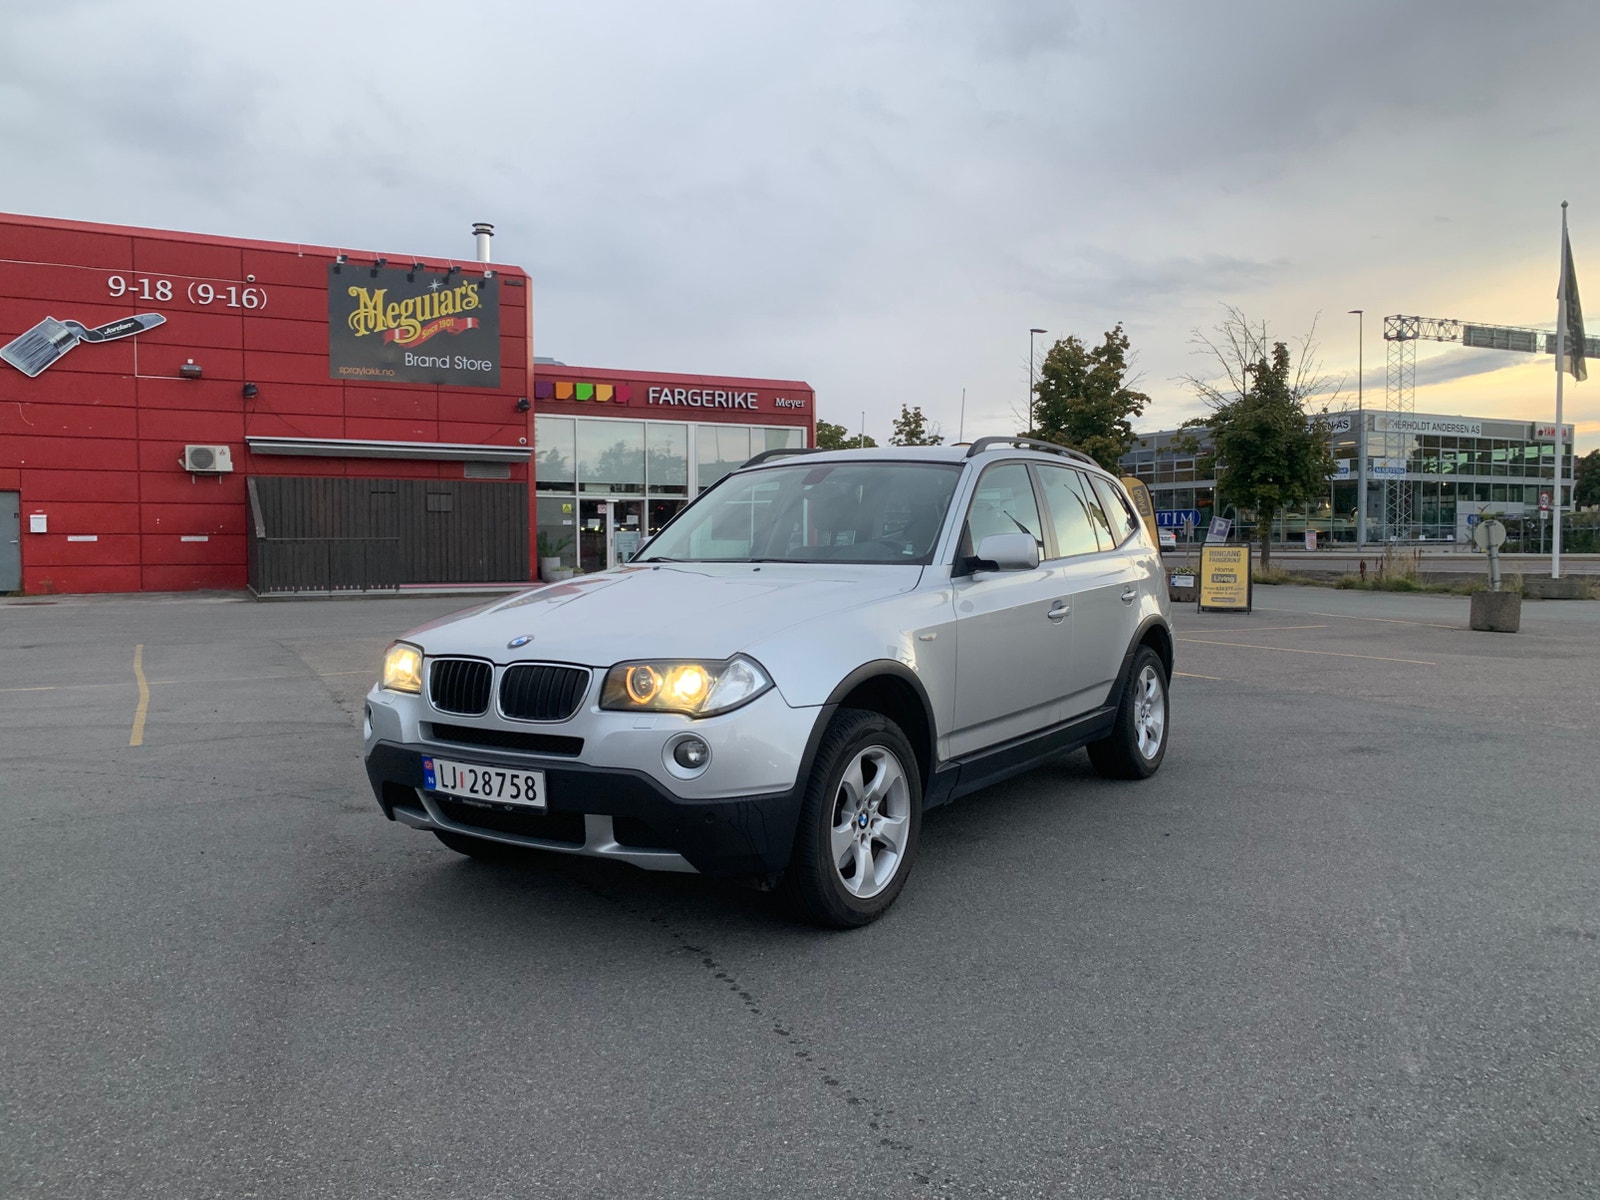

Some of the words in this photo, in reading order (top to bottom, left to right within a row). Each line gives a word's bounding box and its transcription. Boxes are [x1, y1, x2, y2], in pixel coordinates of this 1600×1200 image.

[107, 275, 173, 301] 9-18
[187, 281, 267, 310] (9-16)
[348, 280, 479, 344] Meguiar's
[104, 322, 132, 335] Jordan
[422, 324, 438, 339] Since
[439, 318, 454, 328] 1901
[405, 352, 450, 369] Brand
[454, 355, 492, 372] Store
[338, 366, 395, 377] spraylakk.no
[648, 387, 758, 409] FARGERIKE
[775, 397, 805, 409] Meyer
[1432, 422, 1470, 433] ANDERSEN
[1471, 425, 1480, 434] AS
[1213, 520, 1225, 534] P
[428, 776, 435, 784] N
[439, 763, 457, 790] LJ
[468, 768, 537, 801] 28758
